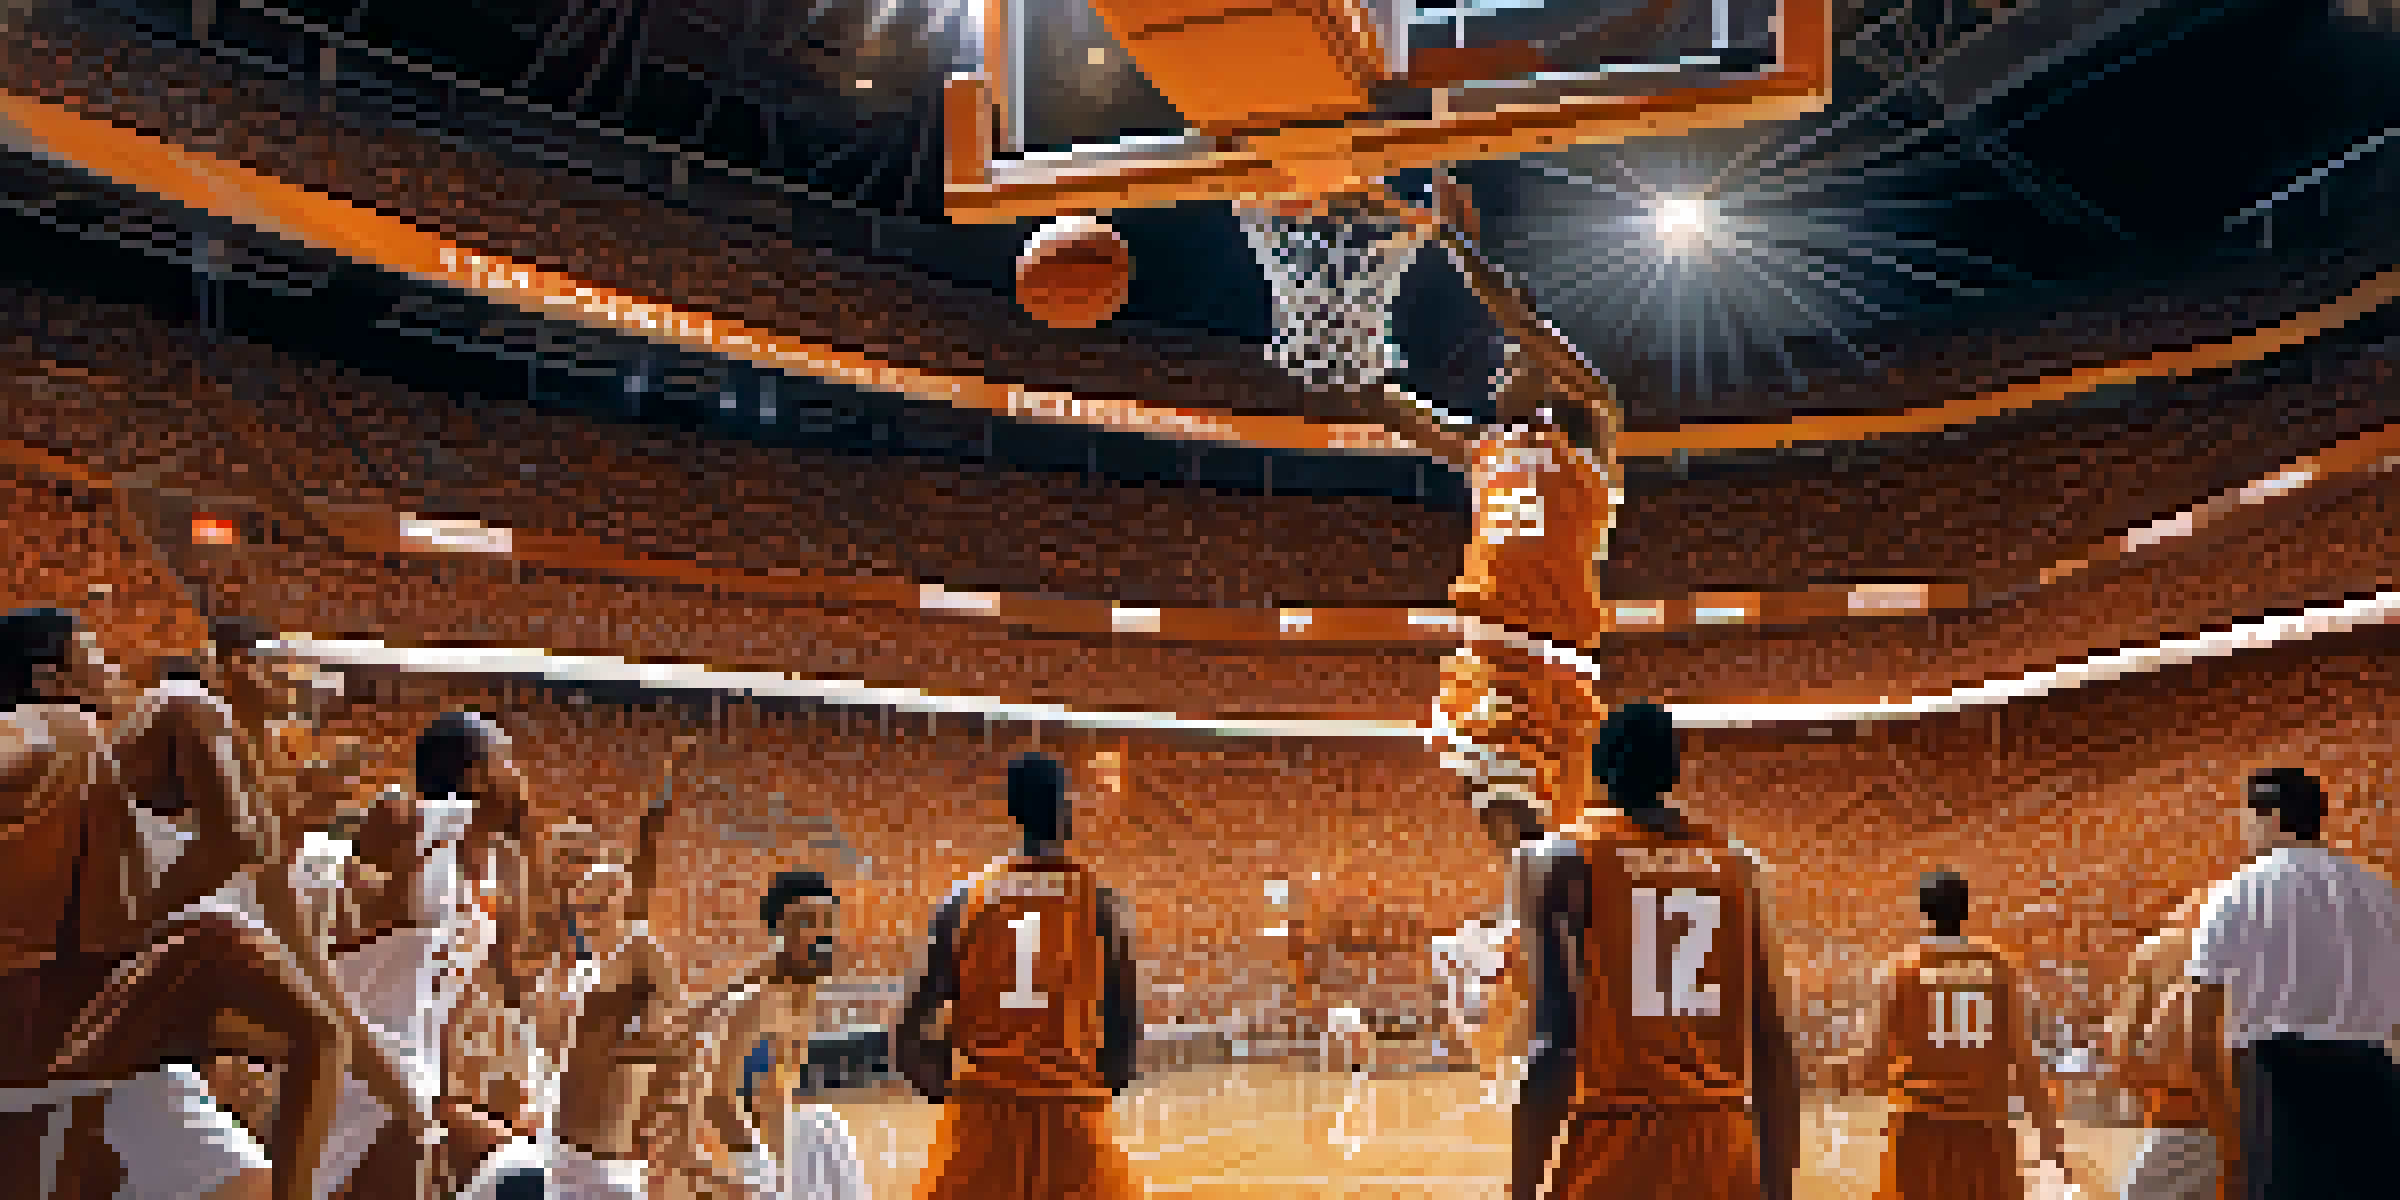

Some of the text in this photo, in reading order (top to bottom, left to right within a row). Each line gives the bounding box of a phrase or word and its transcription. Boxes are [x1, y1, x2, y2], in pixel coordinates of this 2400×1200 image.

[1000, 912, 1048, 1008] 1
[1632, 888, 1720, 1016] 12
[1928, 992, 1992, 1048] 10
